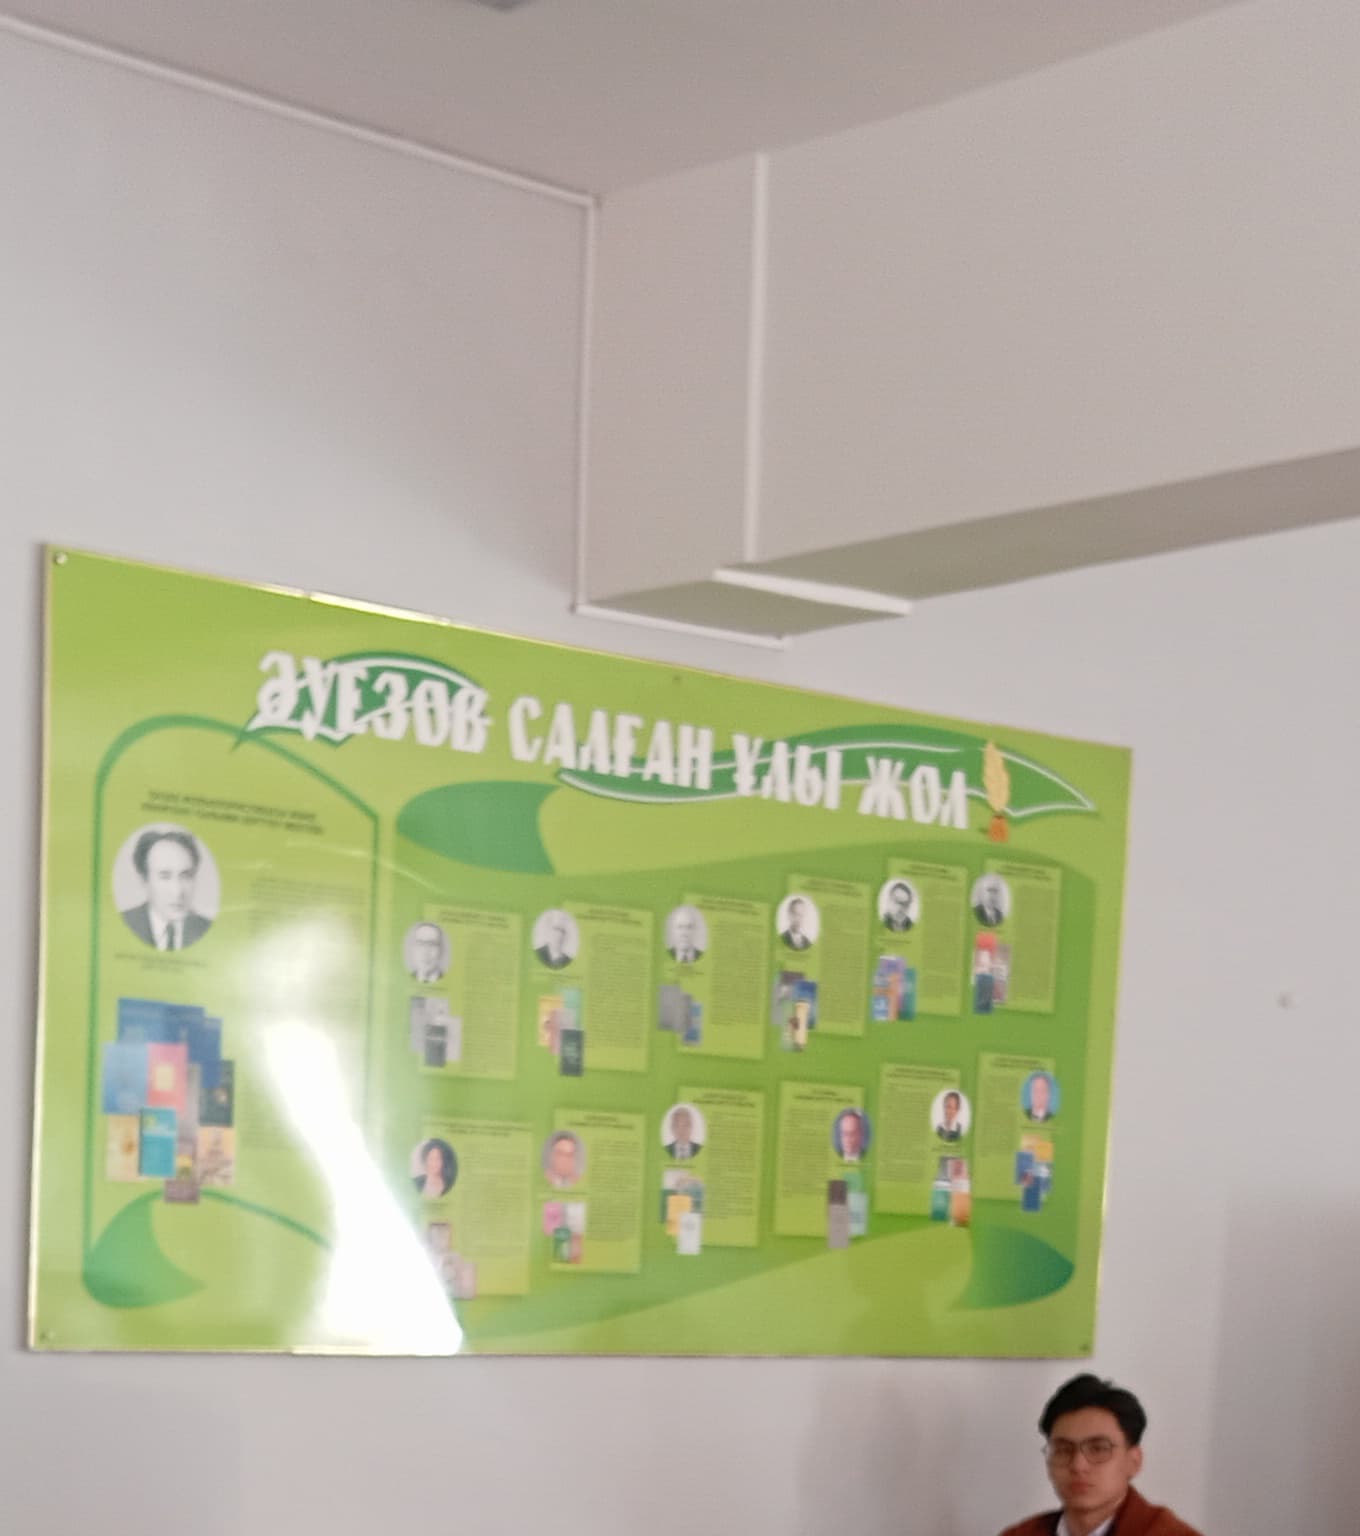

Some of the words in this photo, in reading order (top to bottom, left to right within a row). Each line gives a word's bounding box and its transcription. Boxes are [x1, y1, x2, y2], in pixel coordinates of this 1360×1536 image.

[256, 650, 490, 754] ӘУЕЗОВ
[508, 696, 715, 790] САЛҒАН
[731, 732, 841, 811] ҰЛЫ
[857, 755, 969, 830] ЖОЛ
